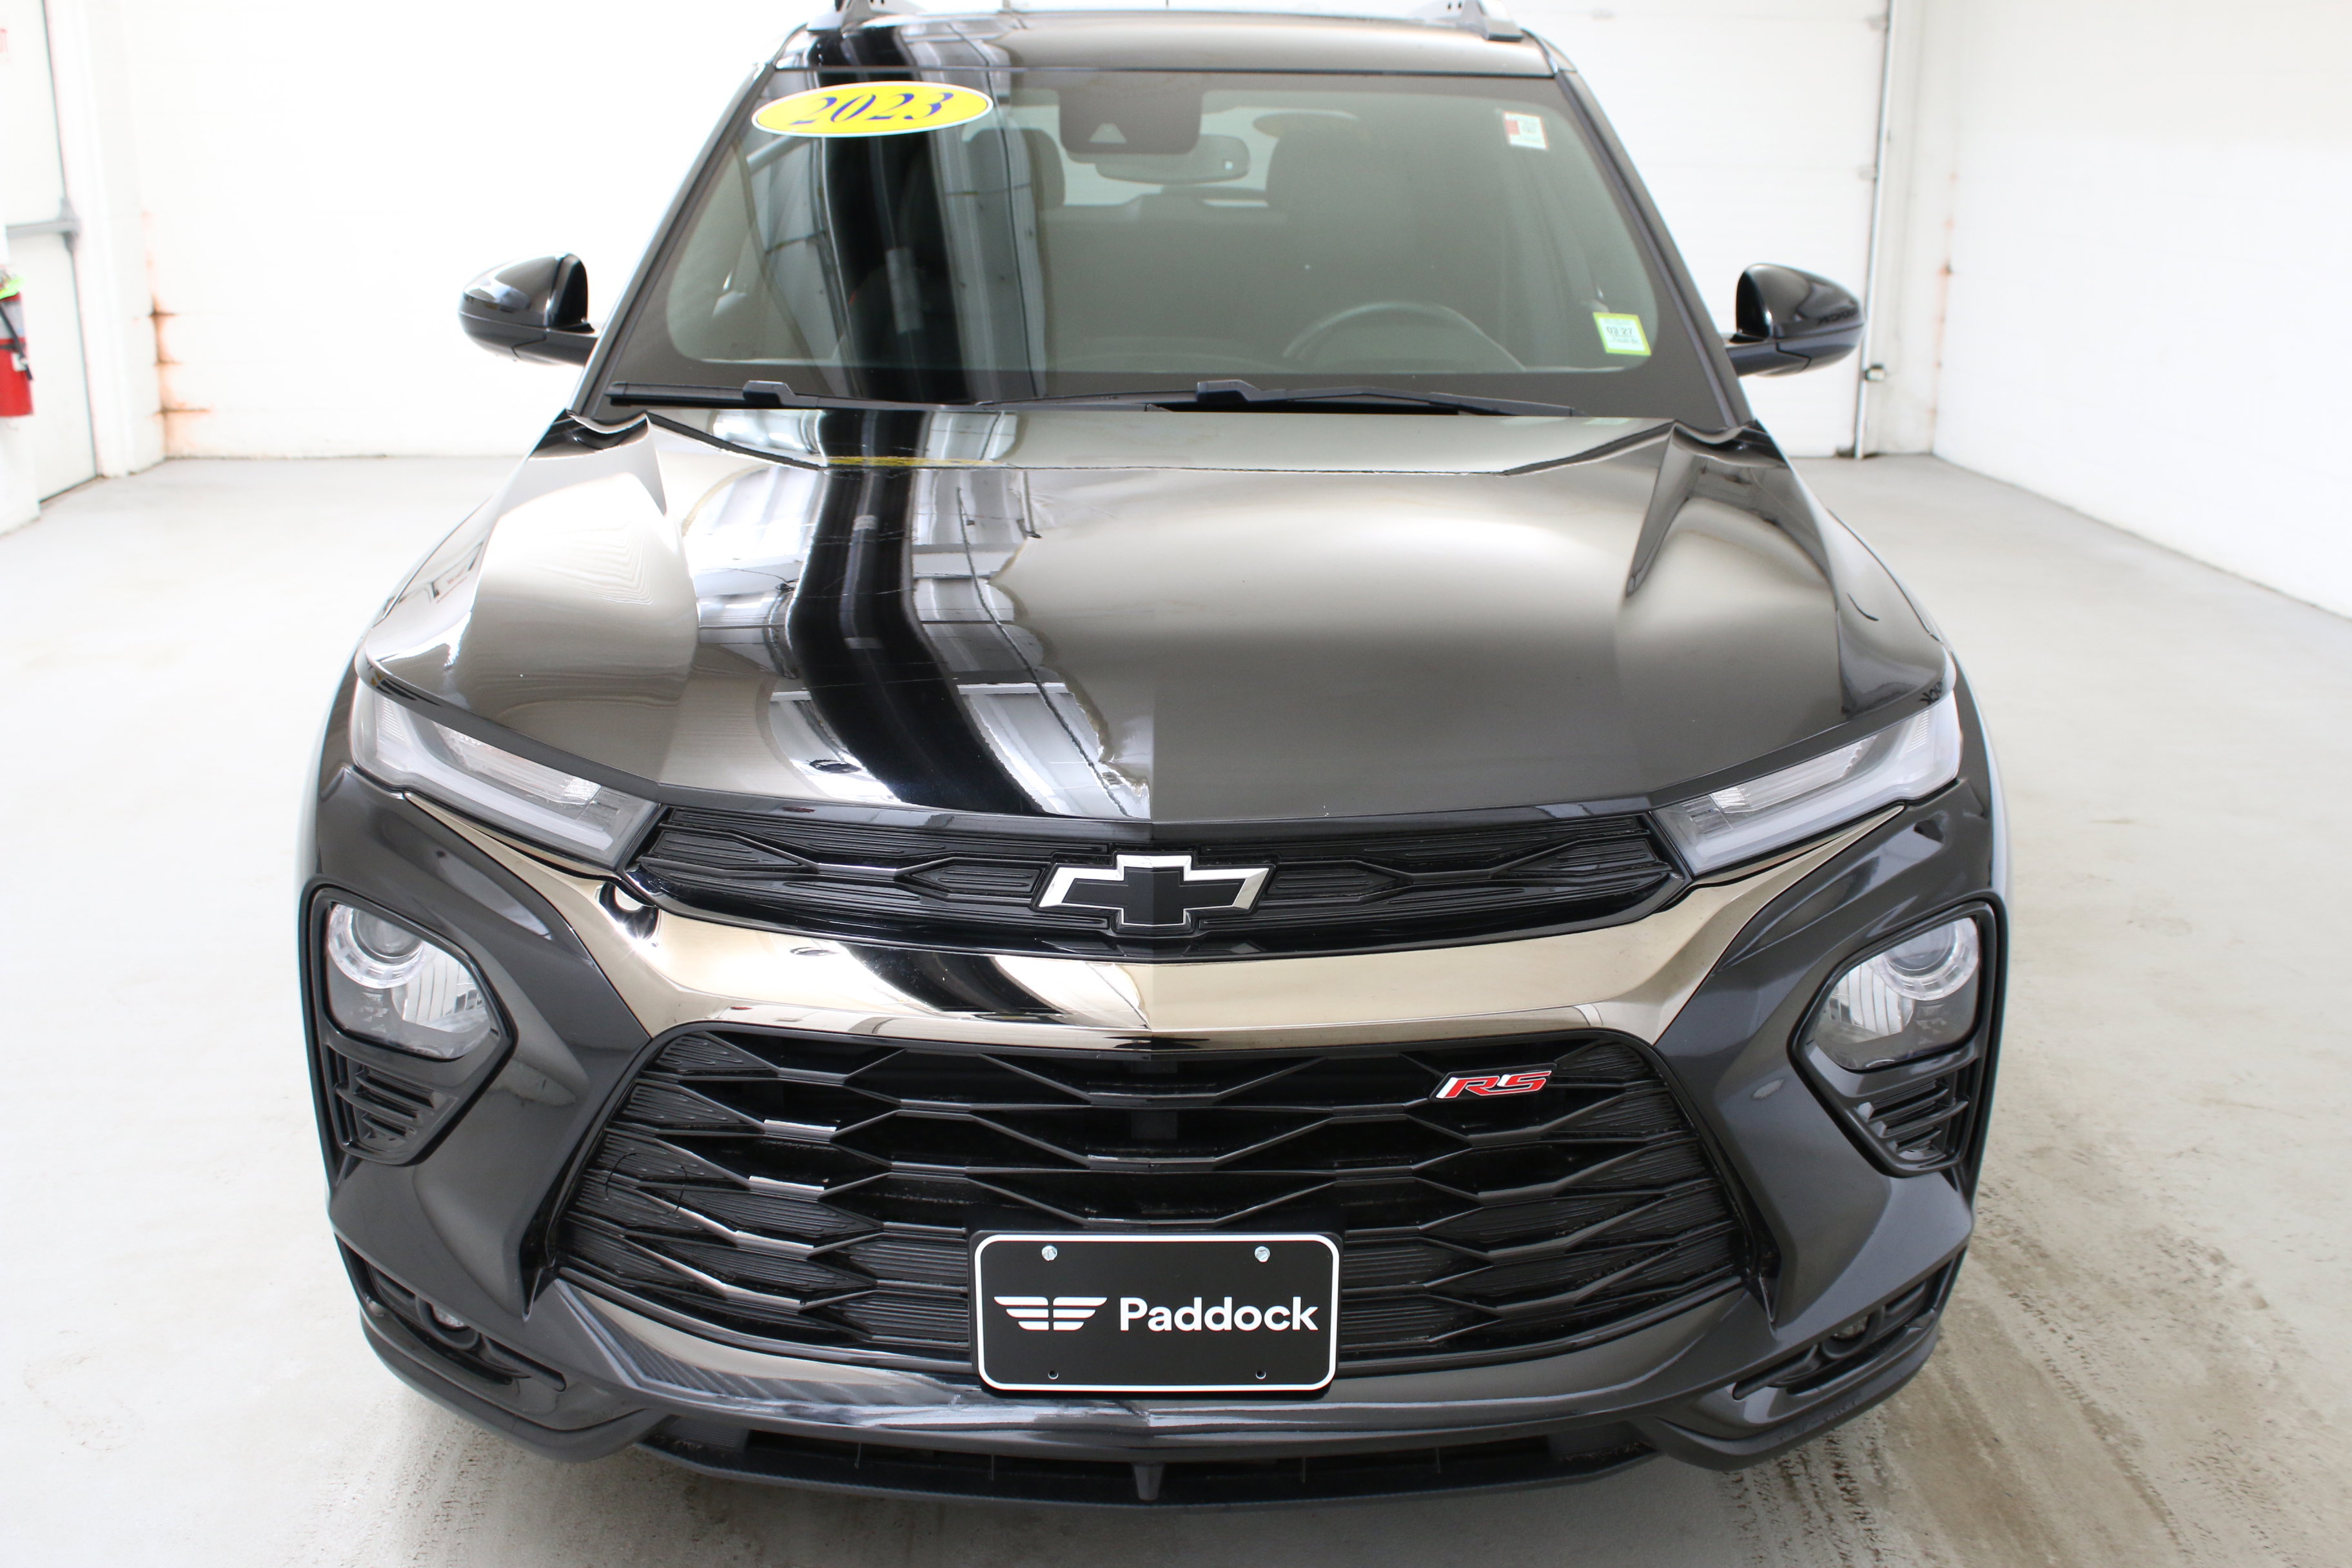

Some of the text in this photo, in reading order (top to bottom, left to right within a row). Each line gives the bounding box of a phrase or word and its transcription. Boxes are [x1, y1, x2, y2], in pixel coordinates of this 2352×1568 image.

[789, 92, 954, 125] 2023
[1436, 1071, 1552, 1099] RS
[1120, 1297, 1318, 1331] Paddock
